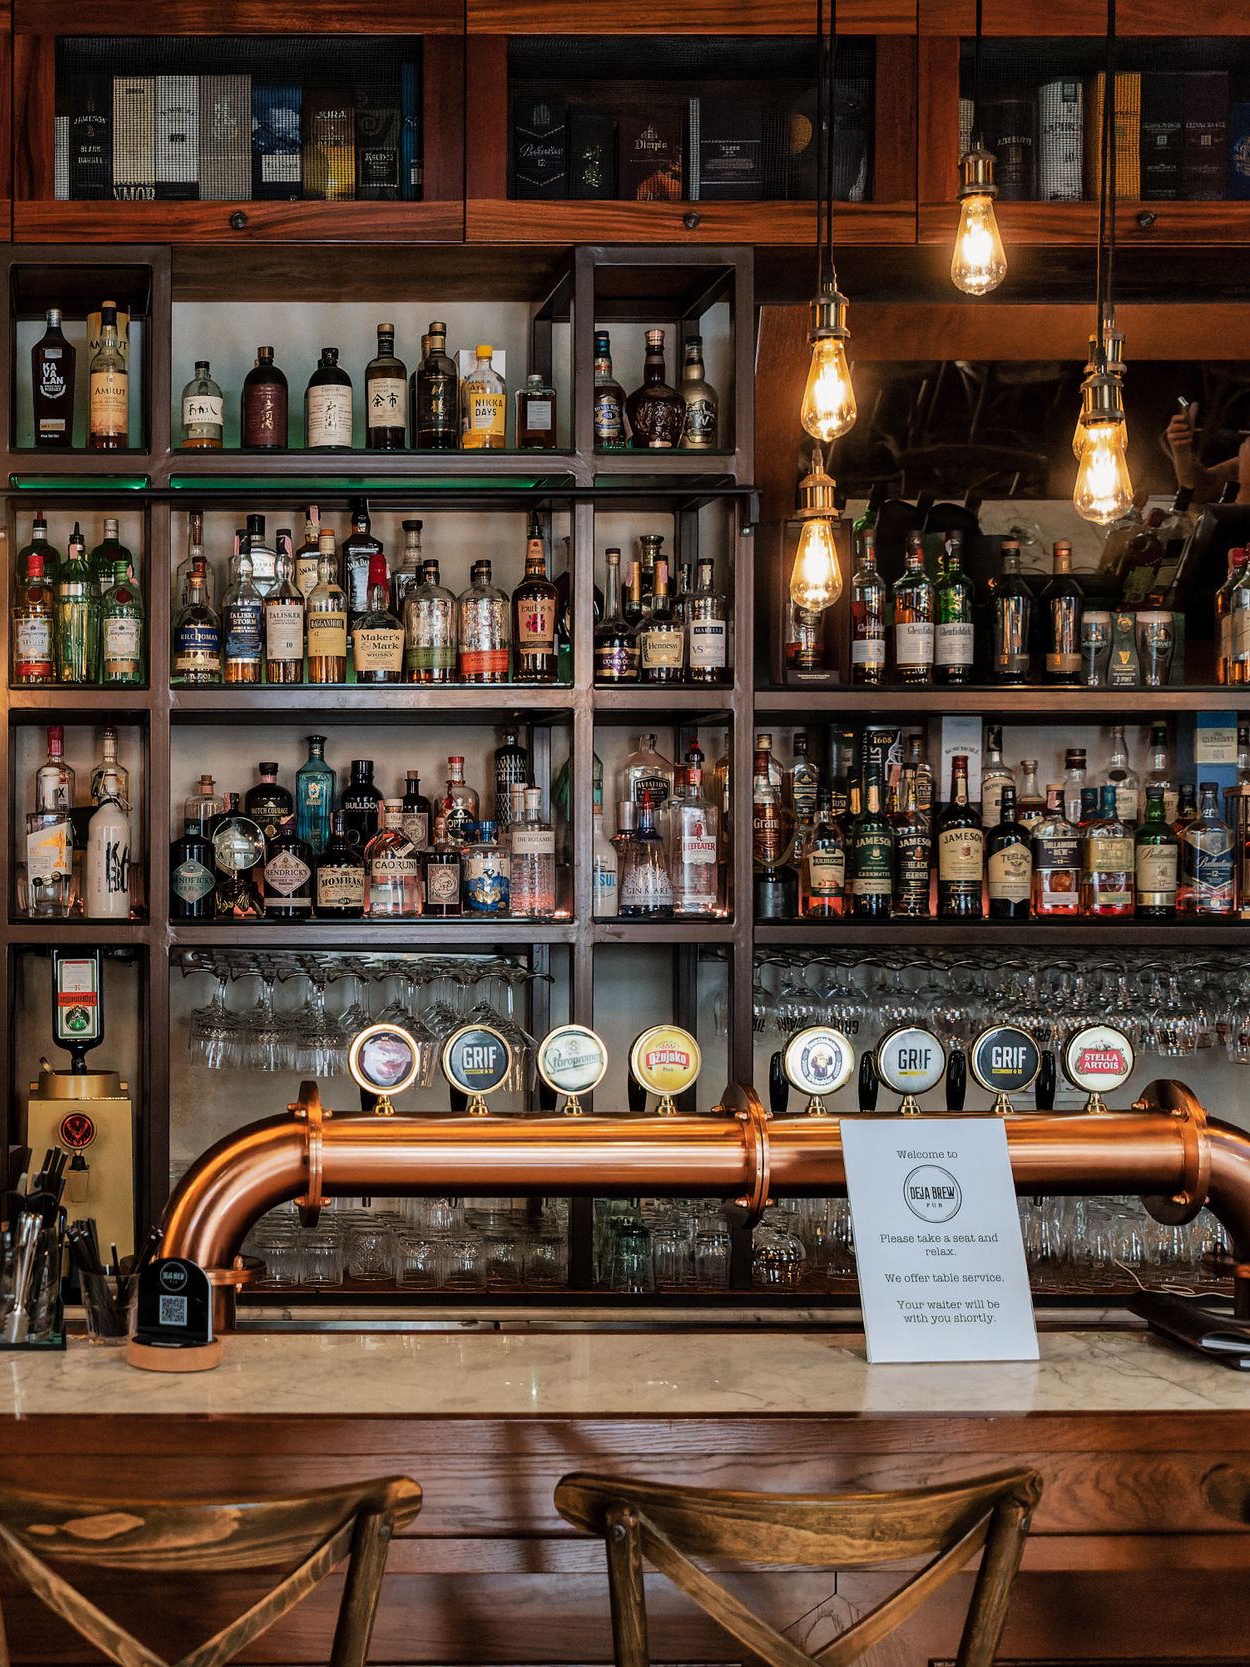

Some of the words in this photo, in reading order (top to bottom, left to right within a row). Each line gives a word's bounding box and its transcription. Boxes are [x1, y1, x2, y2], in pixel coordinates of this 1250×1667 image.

[42, 362, 57, 371] KA
[42, 370, 57, 378] VA
[42, 377, 64, 385] LAN
[95, 387, 126, 396] AMRUT
[371, 393, 399, 409] 余市
[475, 399, 503, 408] NIKKA
[475, 408, 497, 417] DAYS
[873, 735, 893, 744] 1608
[626, 887, 642, 895] GIN
[463, 1047, 496, 1068] GRIF
[898, 1049, 931, 1069] GRIF
[992, 1047, 1027, 1068] GRIF
[1084, 1053, 1119, 1062] STELLA
[1084, 1062, 1119, 1070] ARTOIS
[896, 1150, 945, 1159] Welcome
[947, 1150, 958, 1159] to
[909, 1187, 930, 1200] DEJA
[932, 1187, 955, 1200] BREW
[880, 1234, 915, 1243] Please
[917, 1234, 941, 1243] take
[952, 1234, 976, 1243] seat
[978, 1233, 999, 1242] and
[925, 1248, 957, 1256] relax.
[884, 1273, 902, 1283] We
[904, 1273, 930, 1283] offer
[932, 1273, 960, 1283] table
[962, 1273, 1005, 1283] service.
[896, 1300, 925, 1310] Your
[927, 1300, 962, 1310] waiter
[965, 1300, 985, 1309] will
[987, 1300, 1000, 1309] be
[903, 1314, 928, 1323] with
[931, 1316, 951, 1325] you
[953, 1313, 997, 1324] shortly.
